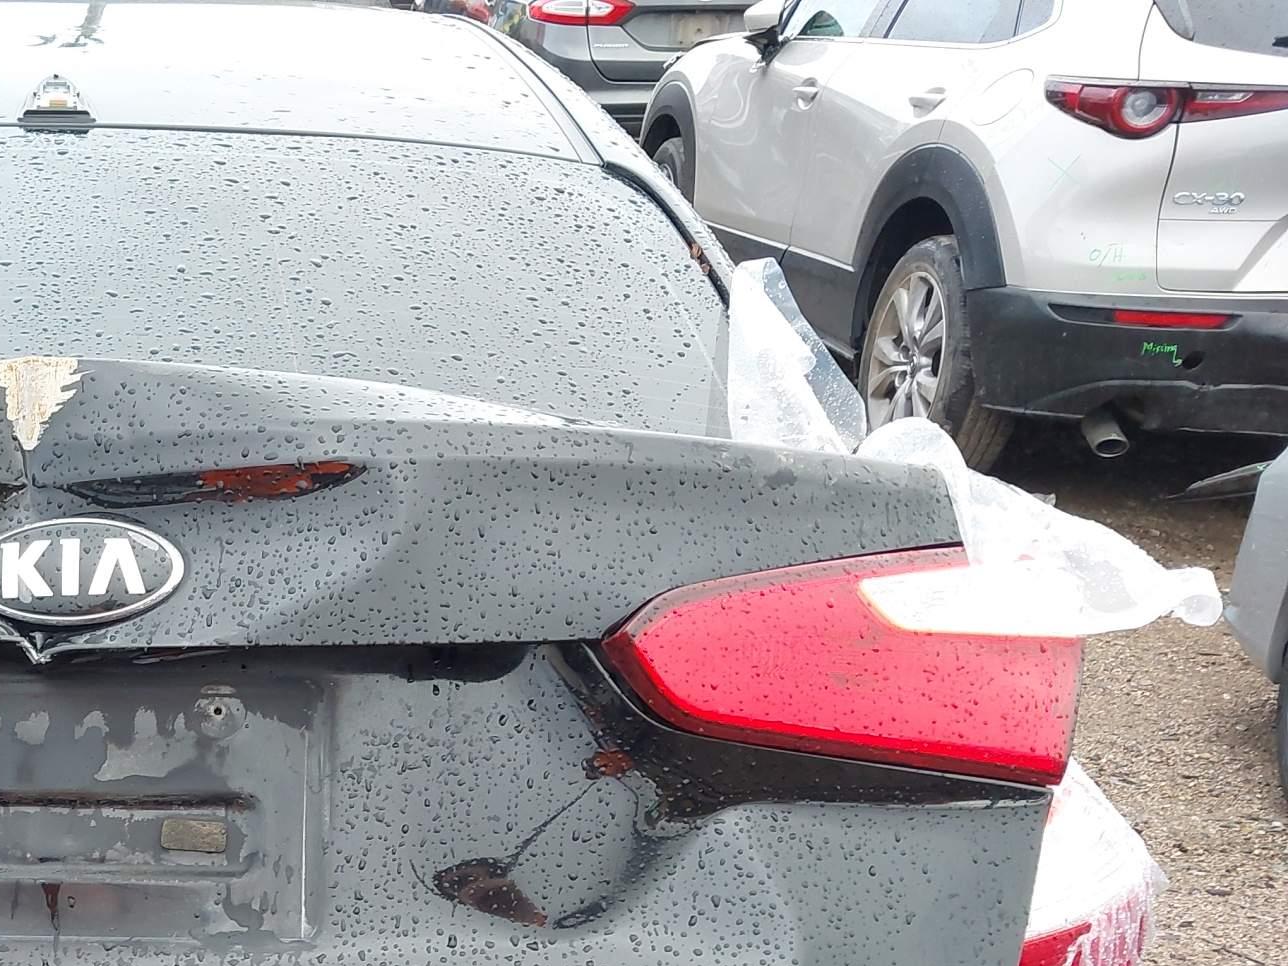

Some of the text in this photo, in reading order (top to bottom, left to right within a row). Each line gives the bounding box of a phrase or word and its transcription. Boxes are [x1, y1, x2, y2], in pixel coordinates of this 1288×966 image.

[1173, 191, 1246, 206] CX-30
[1209, 206, 1238, 215] AWD
[0, 538, 146, 599] KIA
